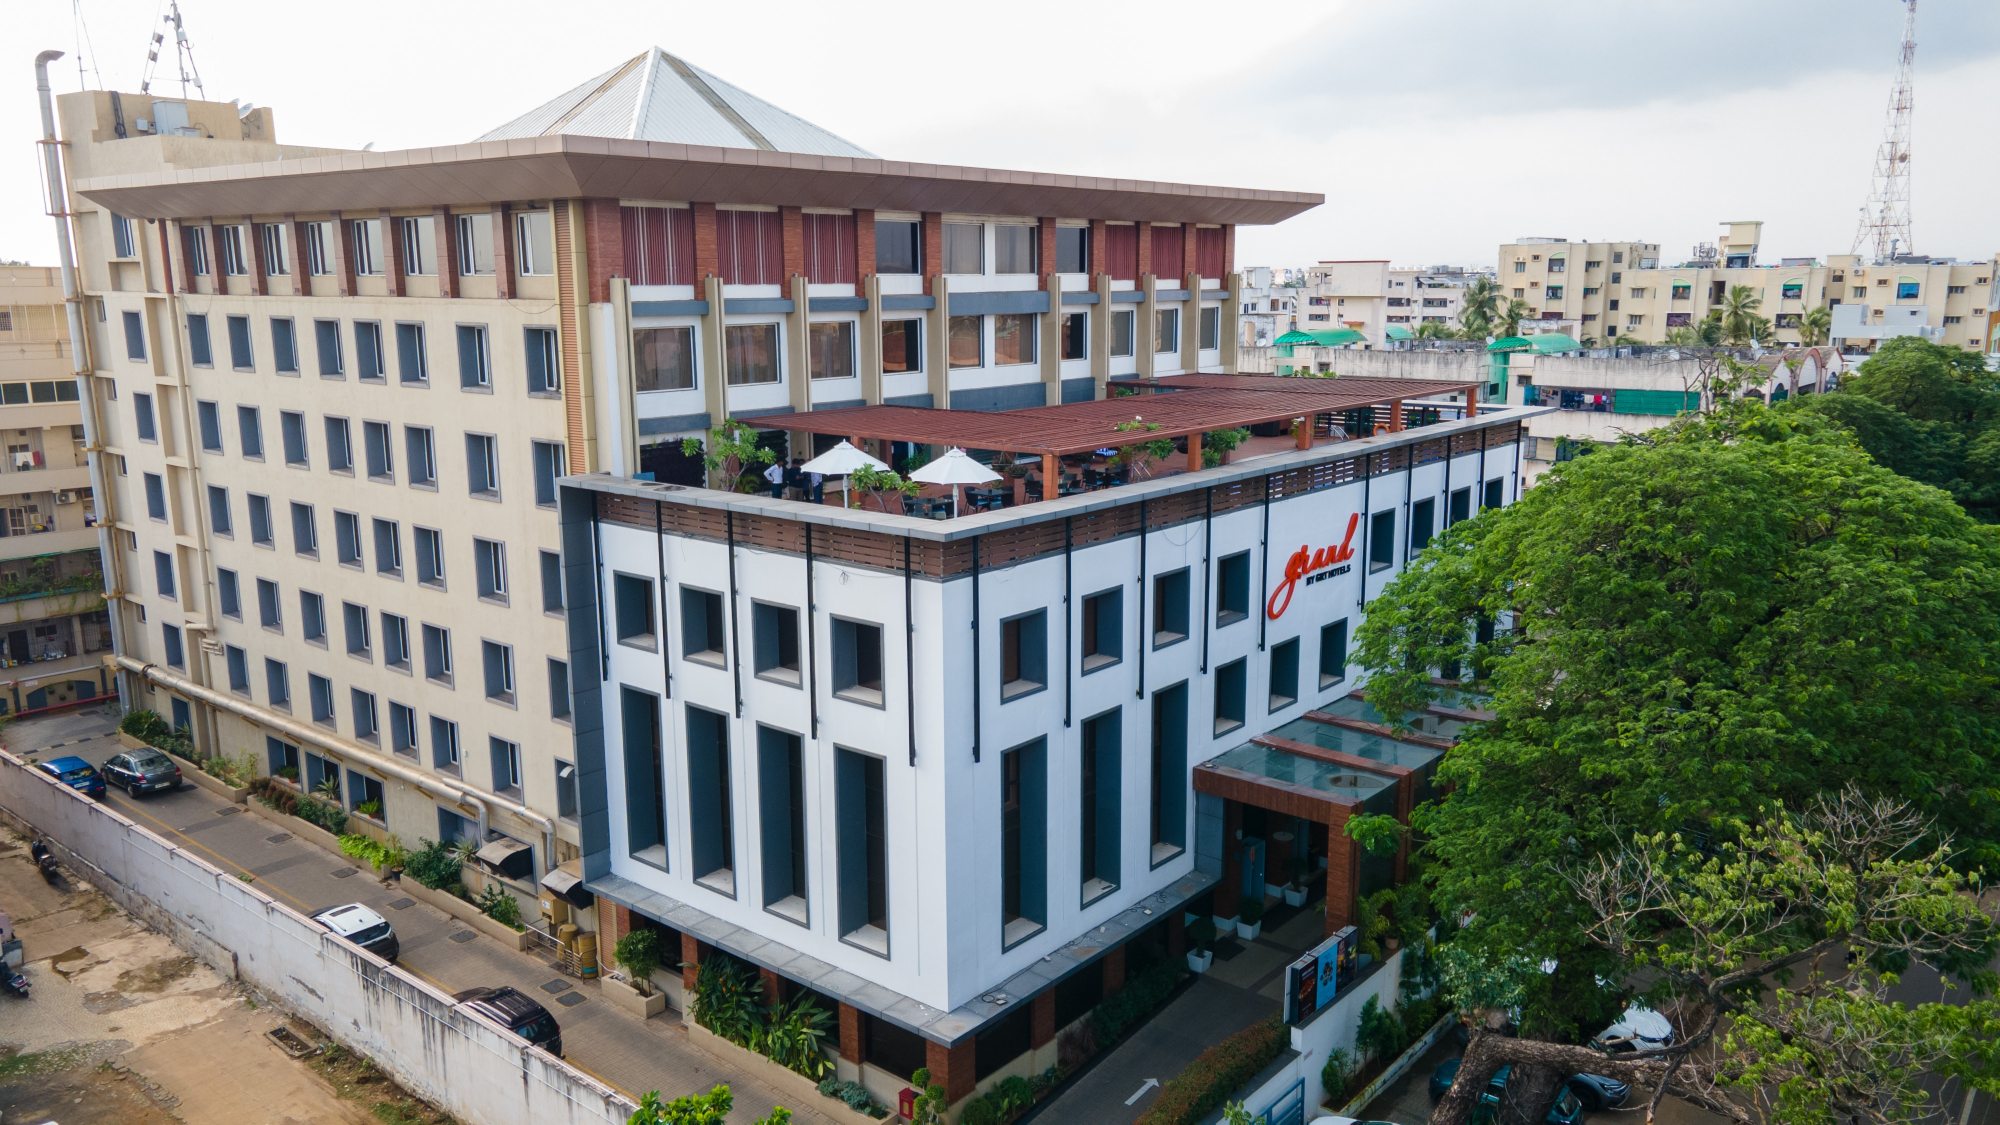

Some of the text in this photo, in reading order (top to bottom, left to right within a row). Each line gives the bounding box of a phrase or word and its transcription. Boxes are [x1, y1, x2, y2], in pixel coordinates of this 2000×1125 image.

[1267, 512, 1359, 620] grand
[1306, 575, 1315, 586] BY
[1328, 564, 1351, 579] HOTELS
